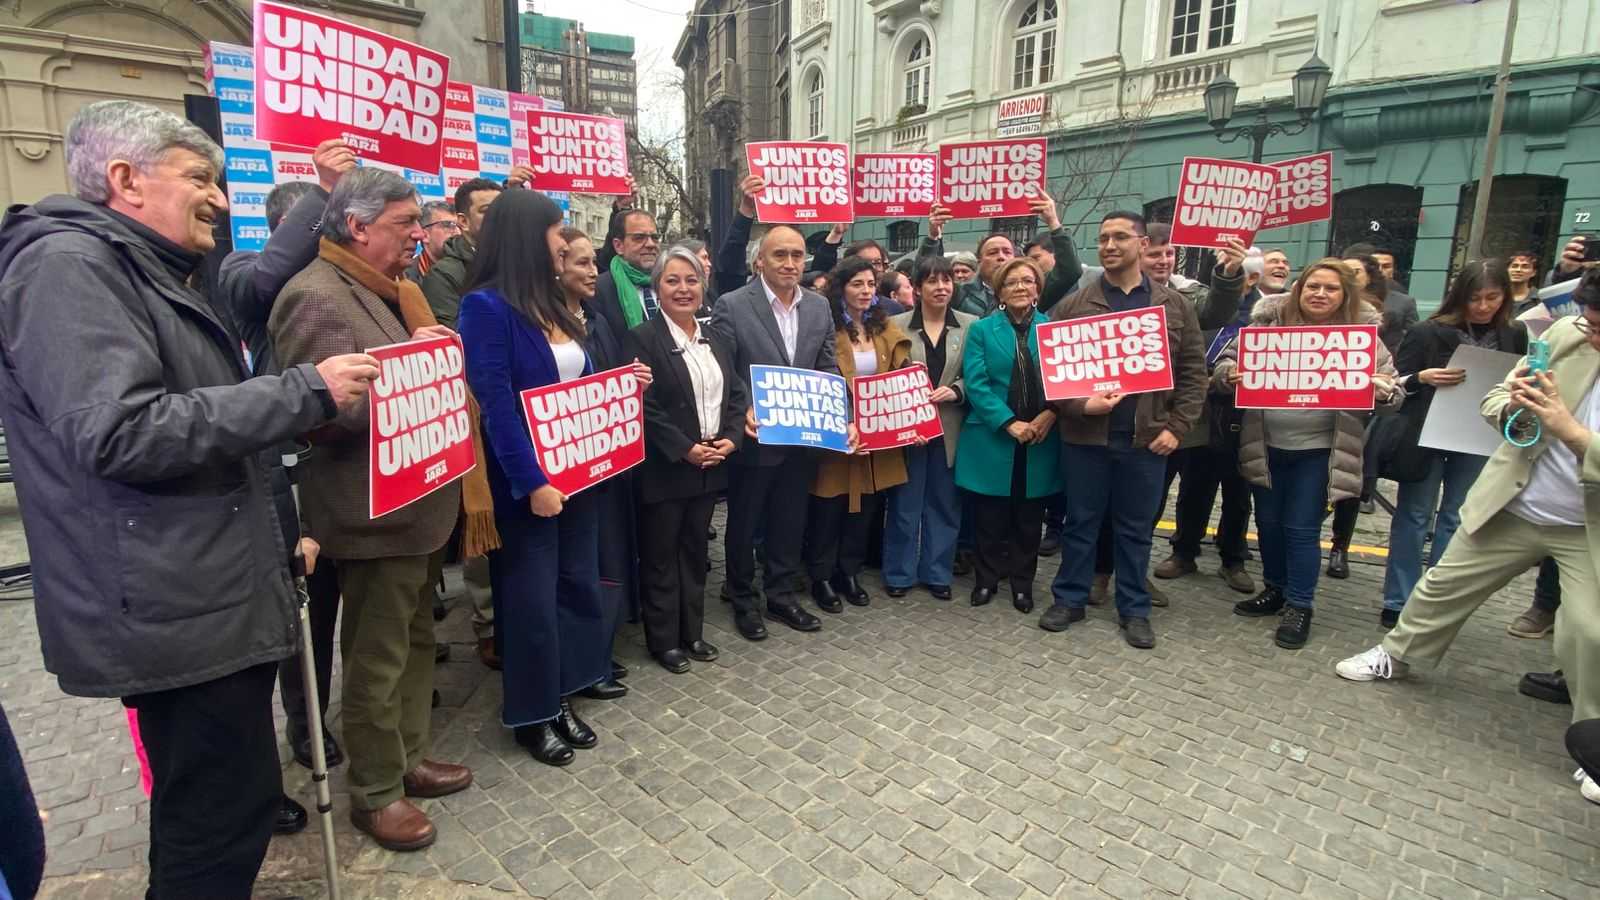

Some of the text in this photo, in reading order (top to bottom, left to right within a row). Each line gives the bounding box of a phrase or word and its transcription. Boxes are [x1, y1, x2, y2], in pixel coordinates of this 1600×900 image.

[213, 55, 254, 68] JARA
[264, 13, 443, 88] UNIDAD
[264, 46, 441, 117] UNIDAD
[446, 92, 471, 103] ARA
[477, 96, 506, 109] JARA
[1000, 96, 1042, 118] ARRIENDO
[264, 80, 437, 146] UNIDAD
[224, 126, 254, 136] JAR
[479, 125, 508, 136] JARA
[531, 116, 623, 142] JUNTOS
[342, 136, 380, 153] JARA
[444, 149, 475, 161] JARA
[532, 135, 624, 160] JUNTOS
[943, 143, 1042, 166] JUNTOS
[228, 161, 269, 172] JARA
[481, 154, 510, 165] JARA
[534, 155, 626, 177] JUNTOS
[753, 147, 847, 167] JUNTOS
[857, 157, 934, 173] JUNTOS
[278, 165, 316, 176] JARA
[760, 167, 847, 186] JUNTOS
[856, 173, 934, 188] JUNTOS
[943, 162, 1042, 185] JUNTOS
[1187, 163, 1273, 192] UNIDAD
[1276, 158, 1328, 182] TOS
[759, 186, 849, 205] JUNTOS
[856, 188, 934, 203] JUNTOS
[943, 181, 1040, 203] JUNTOS
[1183, 184, 1269, 211] UNIDAD
[1266, 190, 1328, 216] NTOS
[795, 210, 817, 218] JARA
[979, 205, 1004, 213] JARA
[1179, 206, 1263, 231] UNIDAD
[1575, 212, 1590, 223] 72
[1042, 312, 1161, 347] JUNTOS
[1045, 332, 1163, 365] JUNTOS
[1244, 331, 1372, 351] UNIDAD
[373, 345, 463, 397] UNIDAD
[1047, 352, 1166, 383] JUNTOS
[1243, 351, 1371, 371] UNIDAD
[757, 371, 844, 399] JUNTAS
[859, 370, 928, 399] UNIDAD
[1093, 382, 1122, 392] JARA
[1242, 370, 1370, 391] UNIDAD
[376, 377, 466, 437] UNIDAD
[530, 373, 638, 421] UNIDAD
[758, 389, 845, 416] JUNTAS
[859, 387, 931, 417] UNIDAD
[537, 396, 640, 448] UNIDAD
[760, 408, 847, 434] JUNTAS
[859, 404, 936, 433] UNIDAD
[378, 410, 470, 476] UNIDAD
[543, 420, 641, 475] UNIDAD
[800, 433, 822, 442] JARA
[424, 464, 448, 484] JARA
[589, 462, 613, 478] JARA
